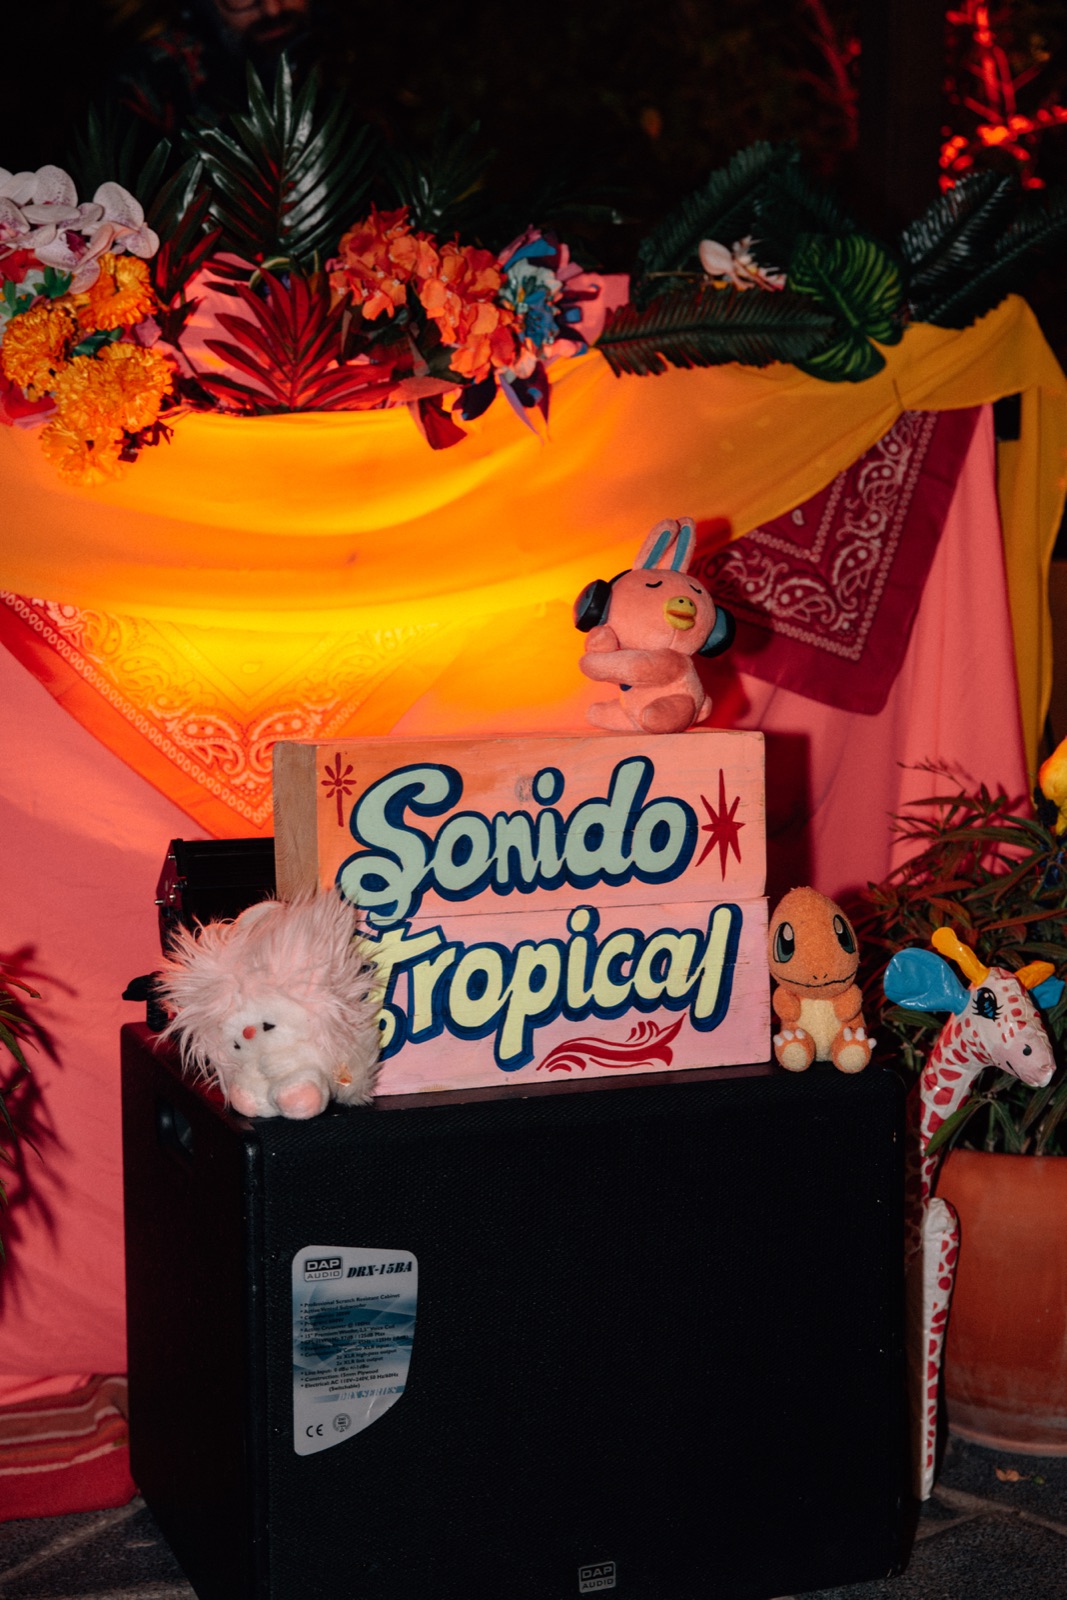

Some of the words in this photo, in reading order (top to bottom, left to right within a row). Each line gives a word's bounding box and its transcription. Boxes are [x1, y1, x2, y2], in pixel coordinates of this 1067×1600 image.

[336, 756, 698, 926] Sonido
[354, 903, 742, 1070] Tropical
[307, 1259, 340, 1271] DAP
[346, 1261, 412, 1278] DRX-15BA
[306, 1270, 340, 1280] AUDIO
[306, 1424, 323, 1438] CE
[582, 1566, 613, 1579] DAP
[582, 1578, 614, 1590] AUDIO
